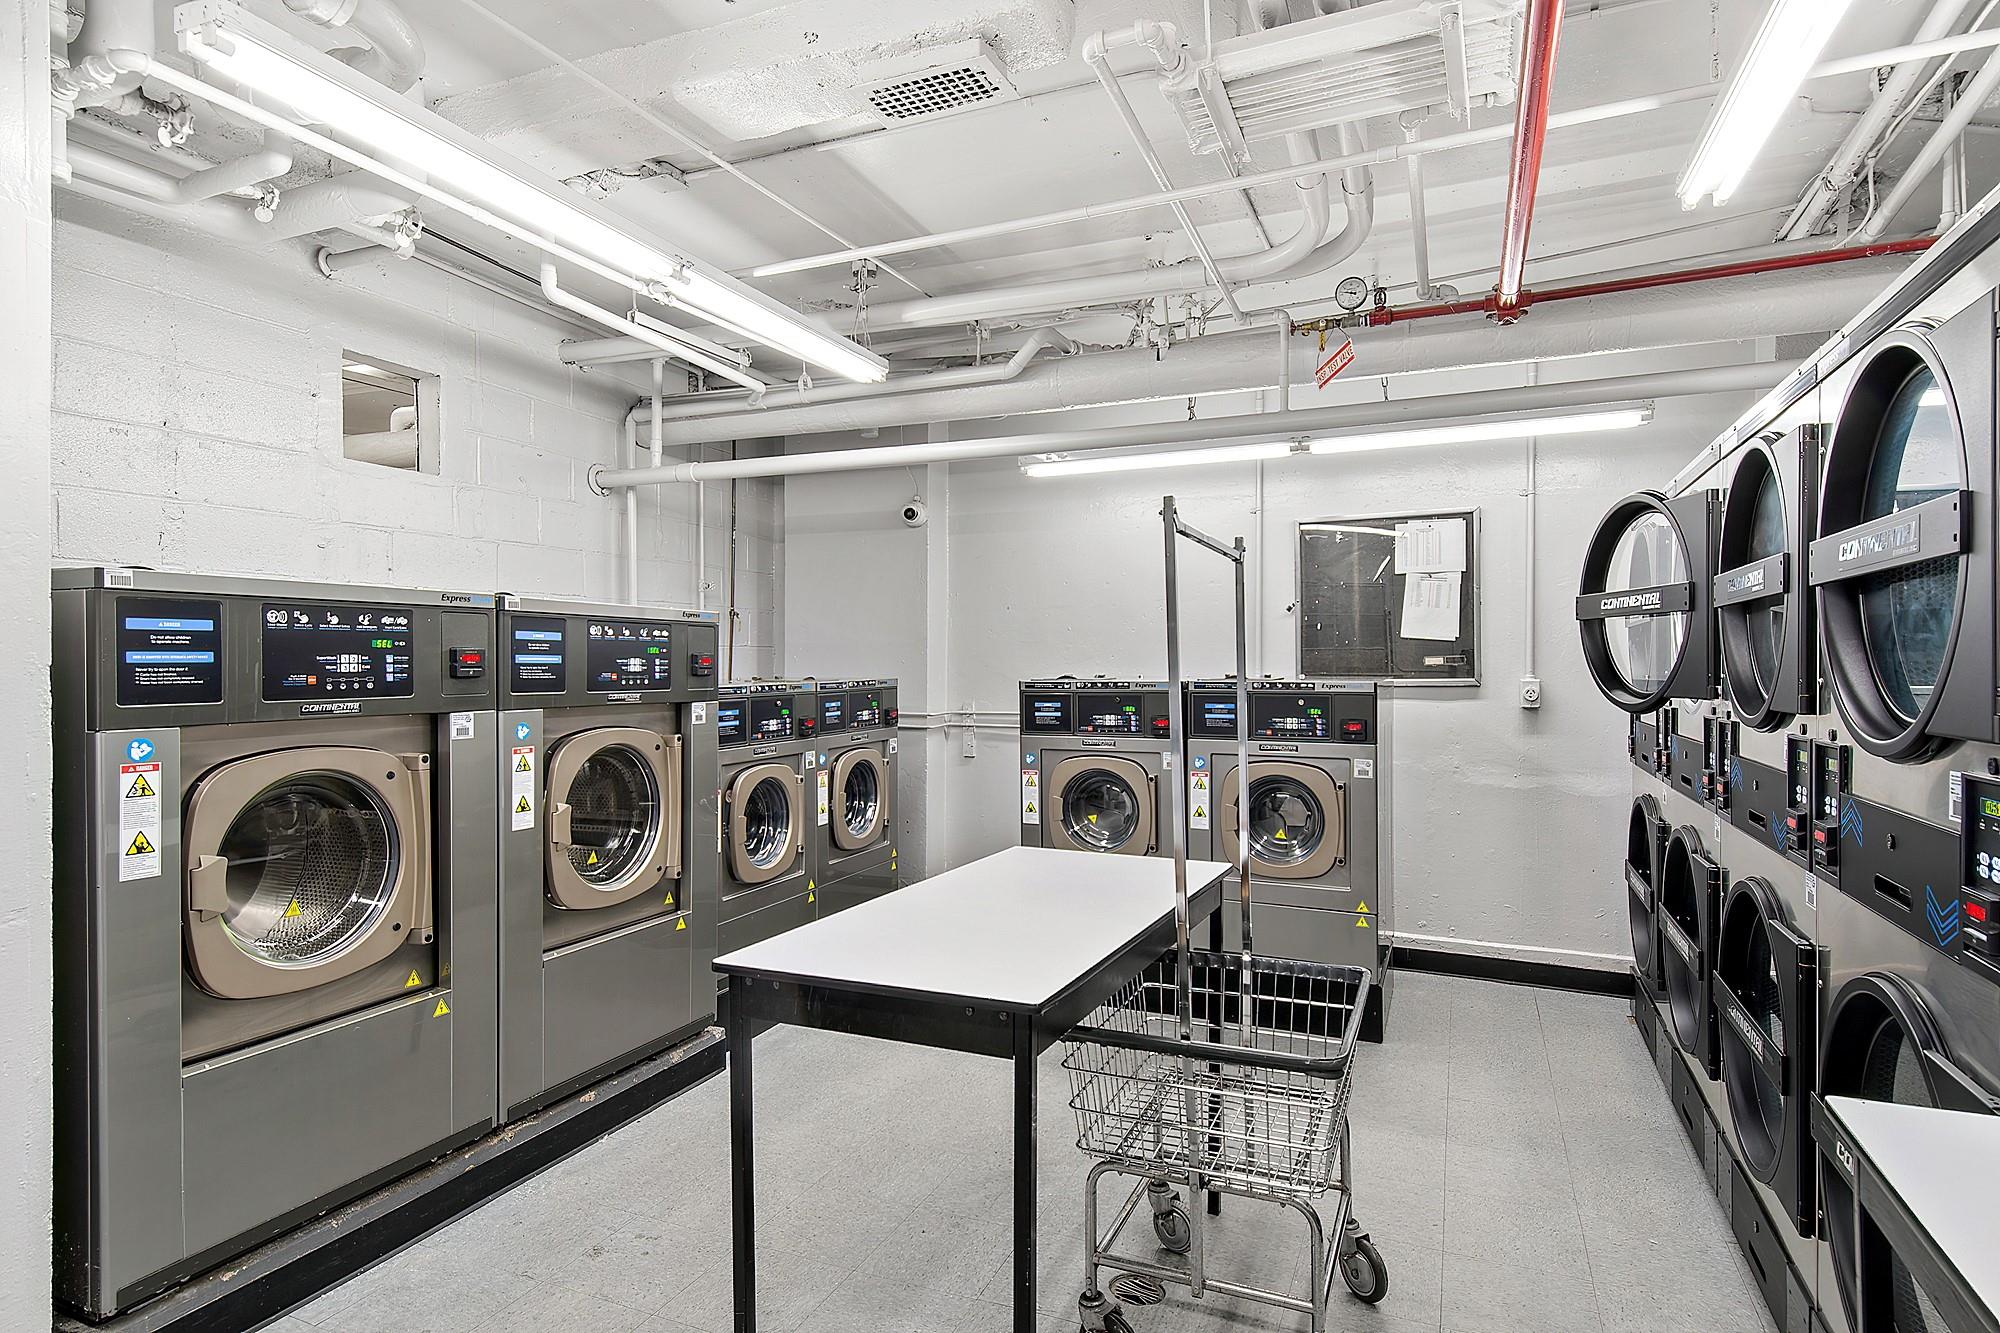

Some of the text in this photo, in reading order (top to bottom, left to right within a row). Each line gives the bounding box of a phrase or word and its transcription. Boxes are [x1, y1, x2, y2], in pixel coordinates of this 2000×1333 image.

[1839, 521, 1917, 561] CONTINENTAL
[441, 594, 471, 603] Express
[1601, 592, 1661, 609] CONTINENTAL
[302, 702, 360, 712] CONTINENTAL
